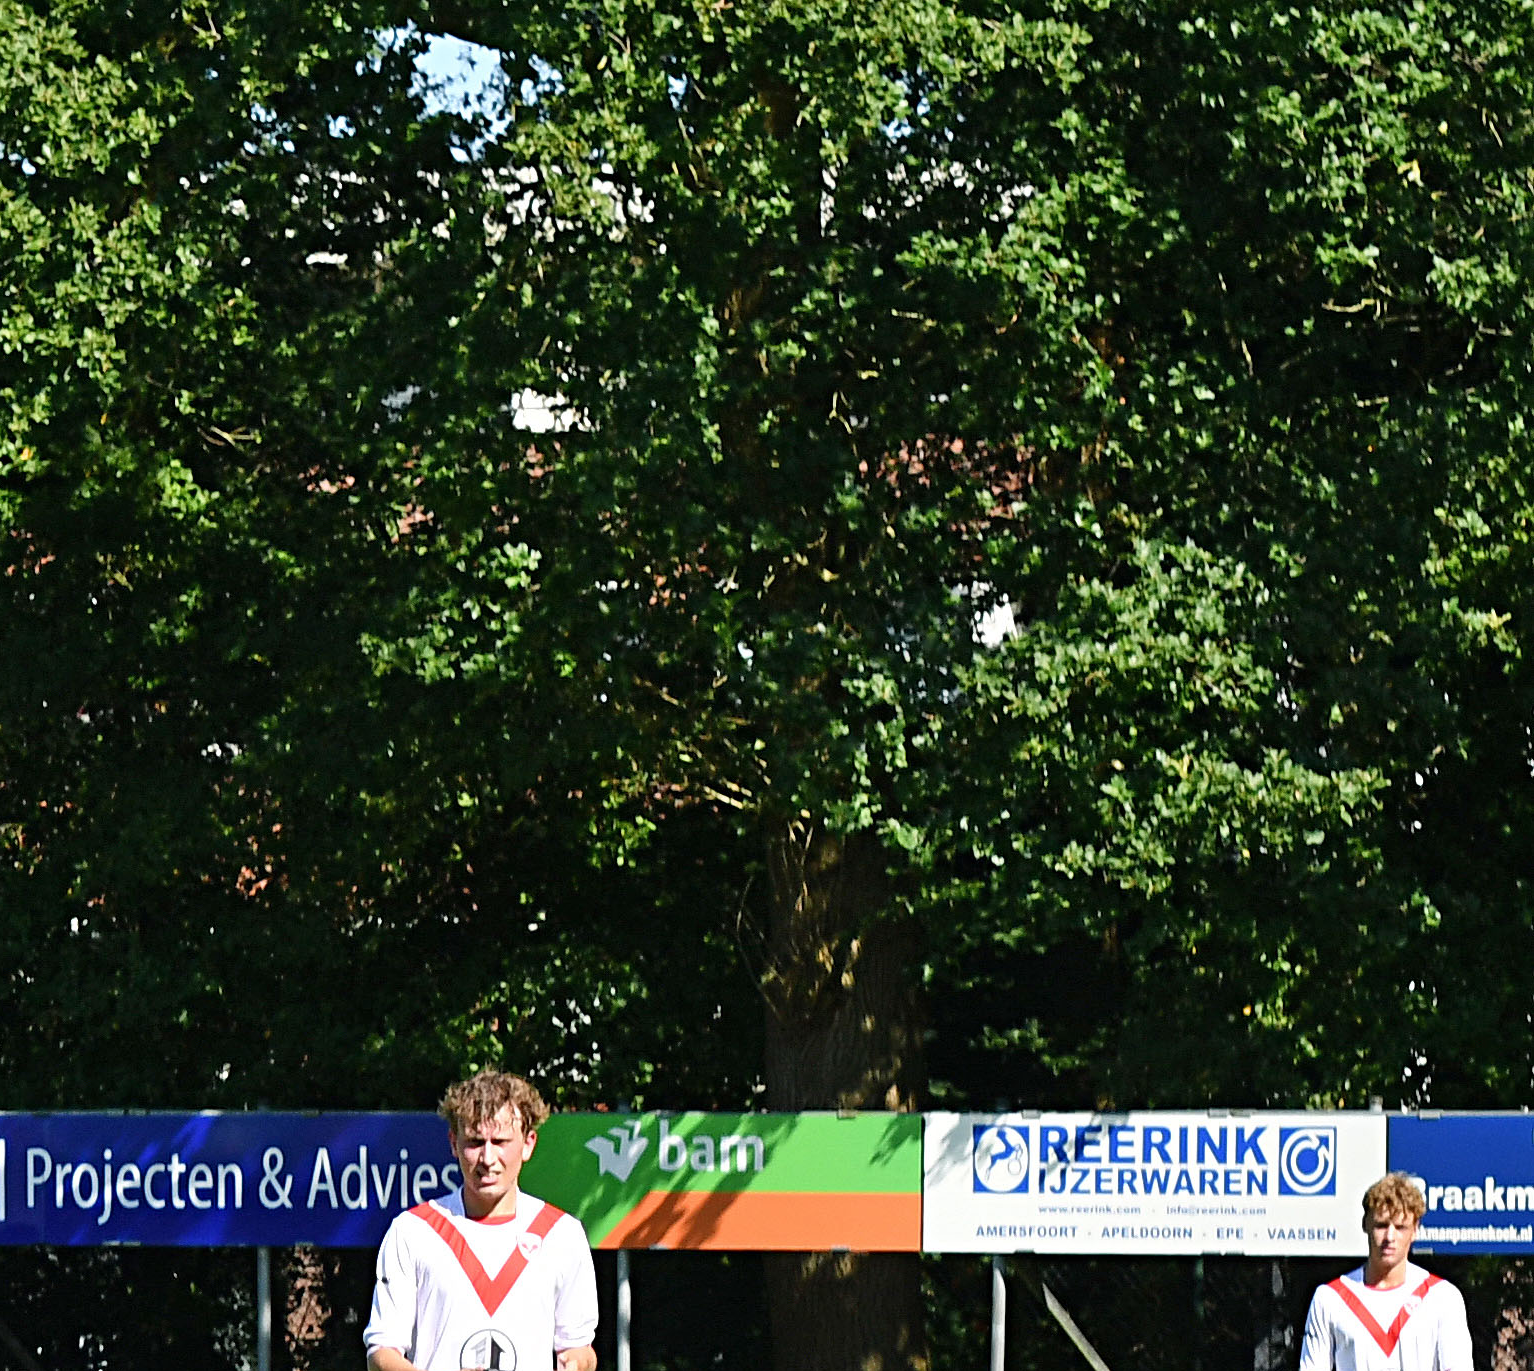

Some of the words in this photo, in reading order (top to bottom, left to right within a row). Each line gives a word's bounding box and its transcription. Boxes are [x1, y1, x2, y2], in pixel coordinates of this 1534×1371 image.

[659, 1118, 765, 1173] bam
[1038, 1124, 1268, 1166] REERINK
[26, 1147, 243, 1226] Projecten
[258, 1146, 294, 1210] &
[306, 1144, 461, 1210] Advies
[1038, 1167, 1269, 1197] IJZERWAREN
[976, 1226, 1079, 1239] AMERSFOORT
[1101, 1226, 1193, 1240] APELDOORN
[1216, 1227, 1244, 1240] EPE
[1267, 1227, 1337, 1241] VAASSEN
